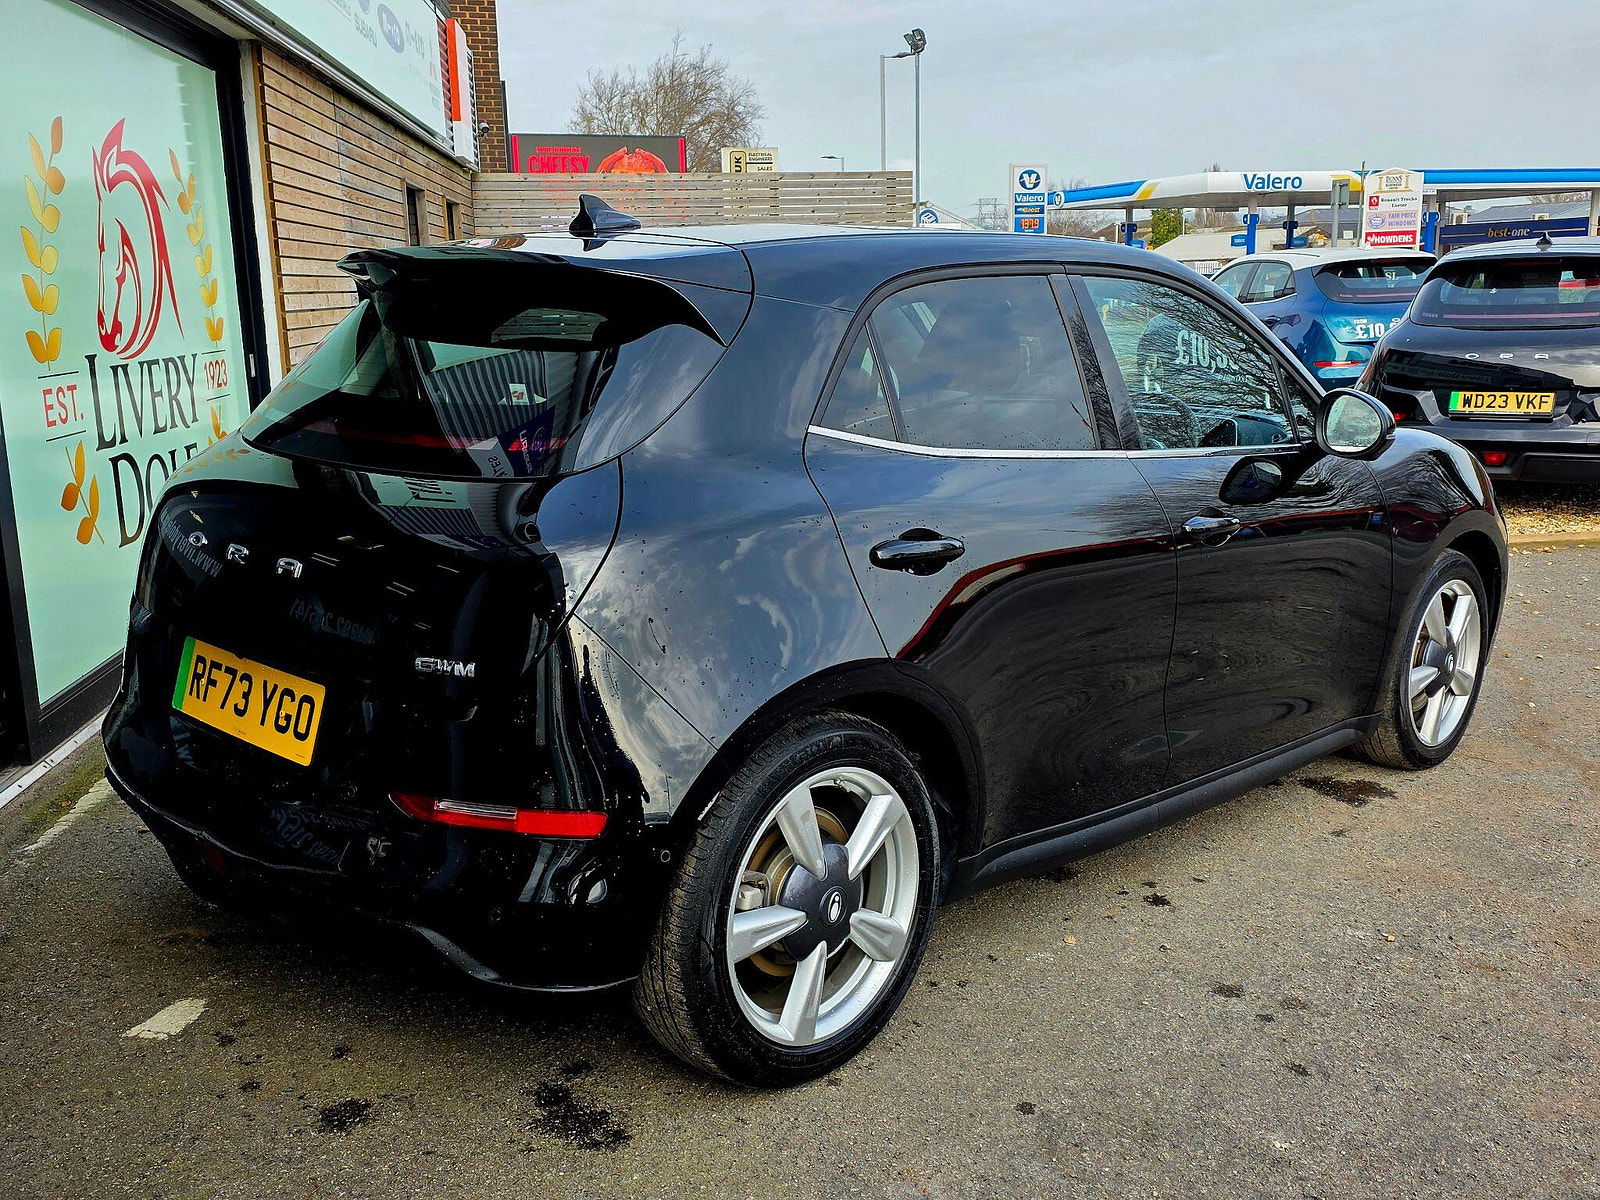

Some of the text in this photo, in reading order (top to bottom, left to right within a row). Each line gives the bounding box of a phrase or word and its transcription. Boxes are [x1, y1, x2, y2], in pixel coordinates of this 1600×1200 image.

[528, 155, 591, 173] CHEESY
[1243, 173, 1303, 190] Valero
[1015, 194, 1044, 202] Valero
[1374, 234, 1414, 244] HOWDENS
[1487, 227, 1530, 238] best-one
[203, 358, 229, 391] 1923
[42, 384, 85, 428] EST.
[84, 353, 200, 452] LIVERY
[1462, 393, 1550, 410] WD23 VKF
[108, 442, 199, 548] DO
[188, 531, 304, 578] ORA
[414, 656, 476, 678] GWM
[187, 653, 317, 743] RF73 YGO
